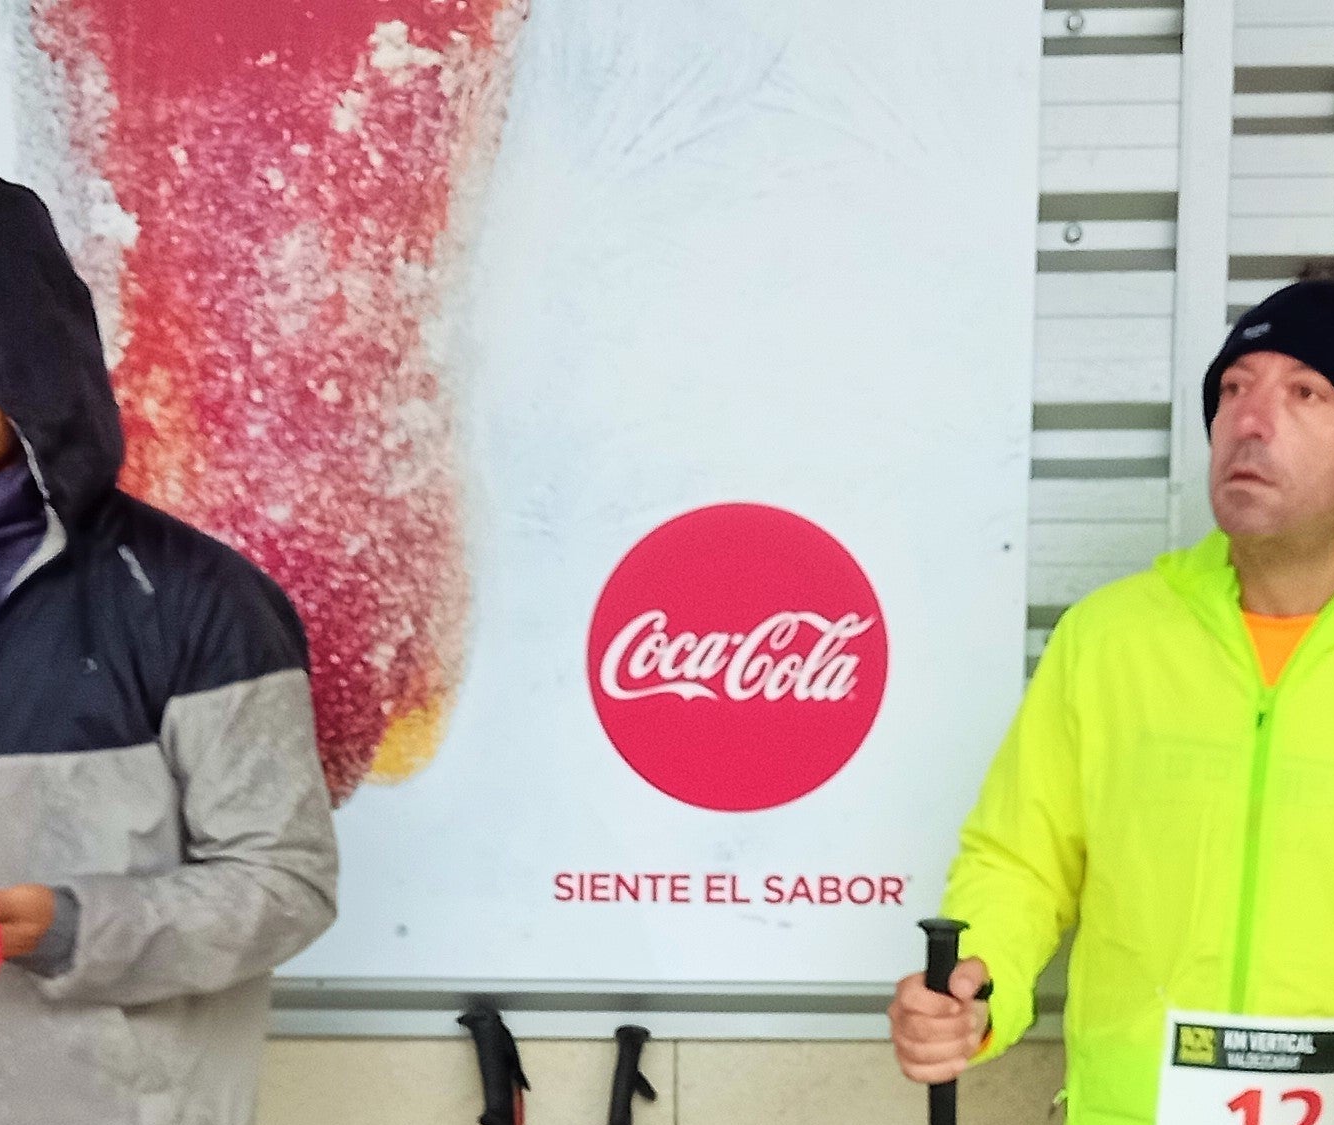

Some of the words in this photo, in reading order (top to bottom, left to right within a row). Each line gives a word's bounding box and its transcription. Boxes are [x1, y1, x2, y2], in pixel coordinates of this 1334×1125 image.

[599, 609, 875, 703] Coca-Cola
[553, 872, 692, 904] SIENTE
[705, 874, 751, 905] EL
[764, 875, 904, 906] SABOR
